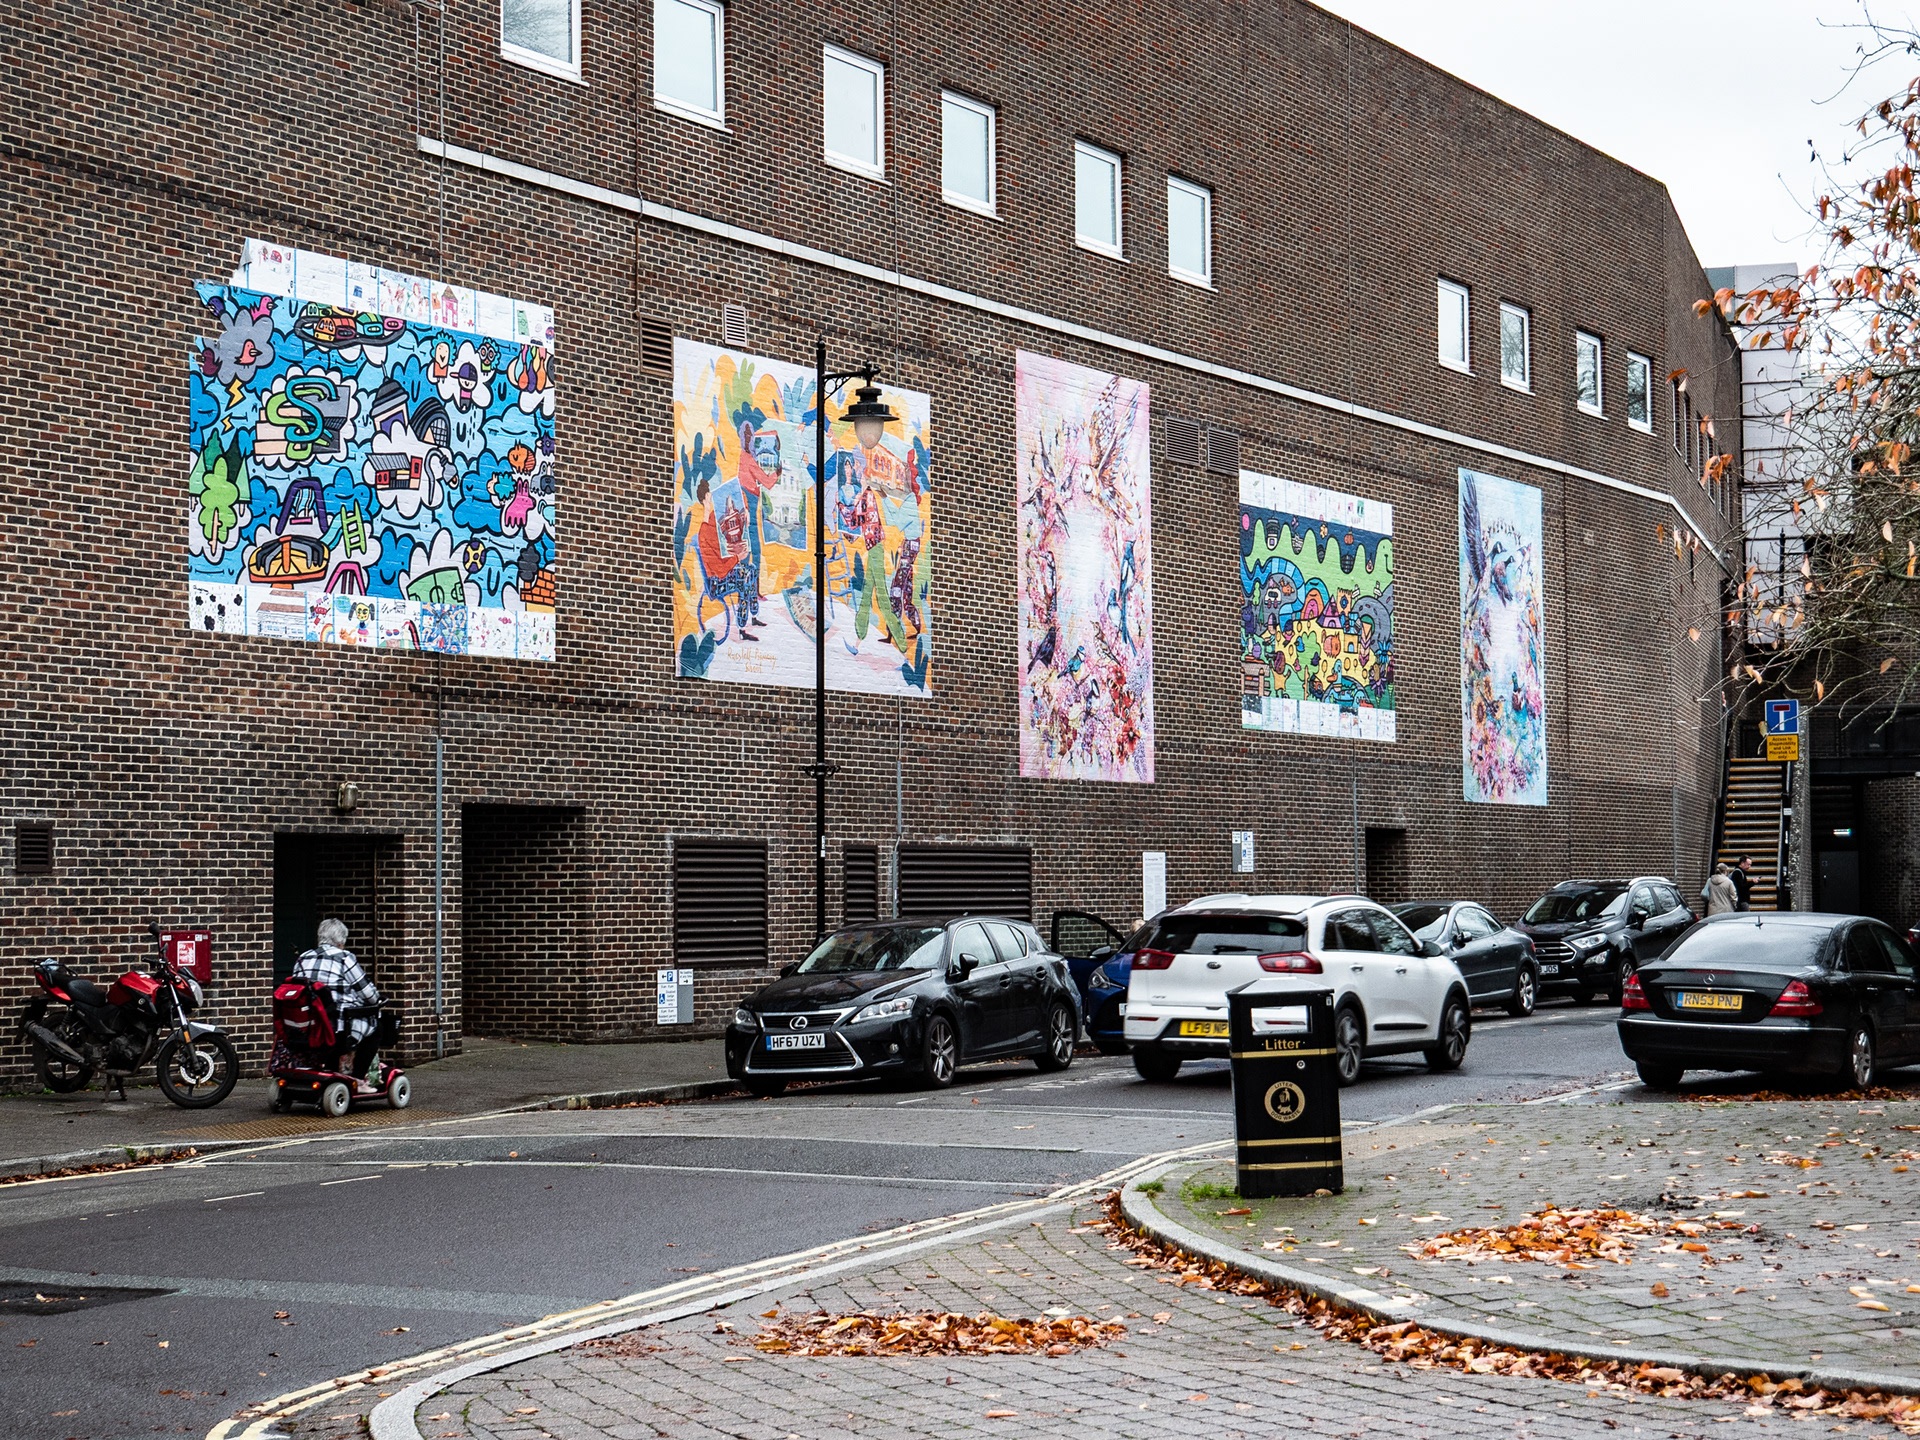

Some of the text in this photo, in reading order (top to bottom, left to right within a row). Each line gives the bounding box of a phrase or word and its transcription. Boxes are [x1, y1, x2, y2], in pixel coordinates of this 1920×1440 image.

[1685, 993, 1740, 1007] RN53 PNJ
[1187, 1022, 1230, 1034] LF19 NP
[772, 1035, 822, 1048] HF67 UZV
[1265, 1038, 1301, 1051] Litter
[1270, 1109, 1301, 1121] DOG WASTE
